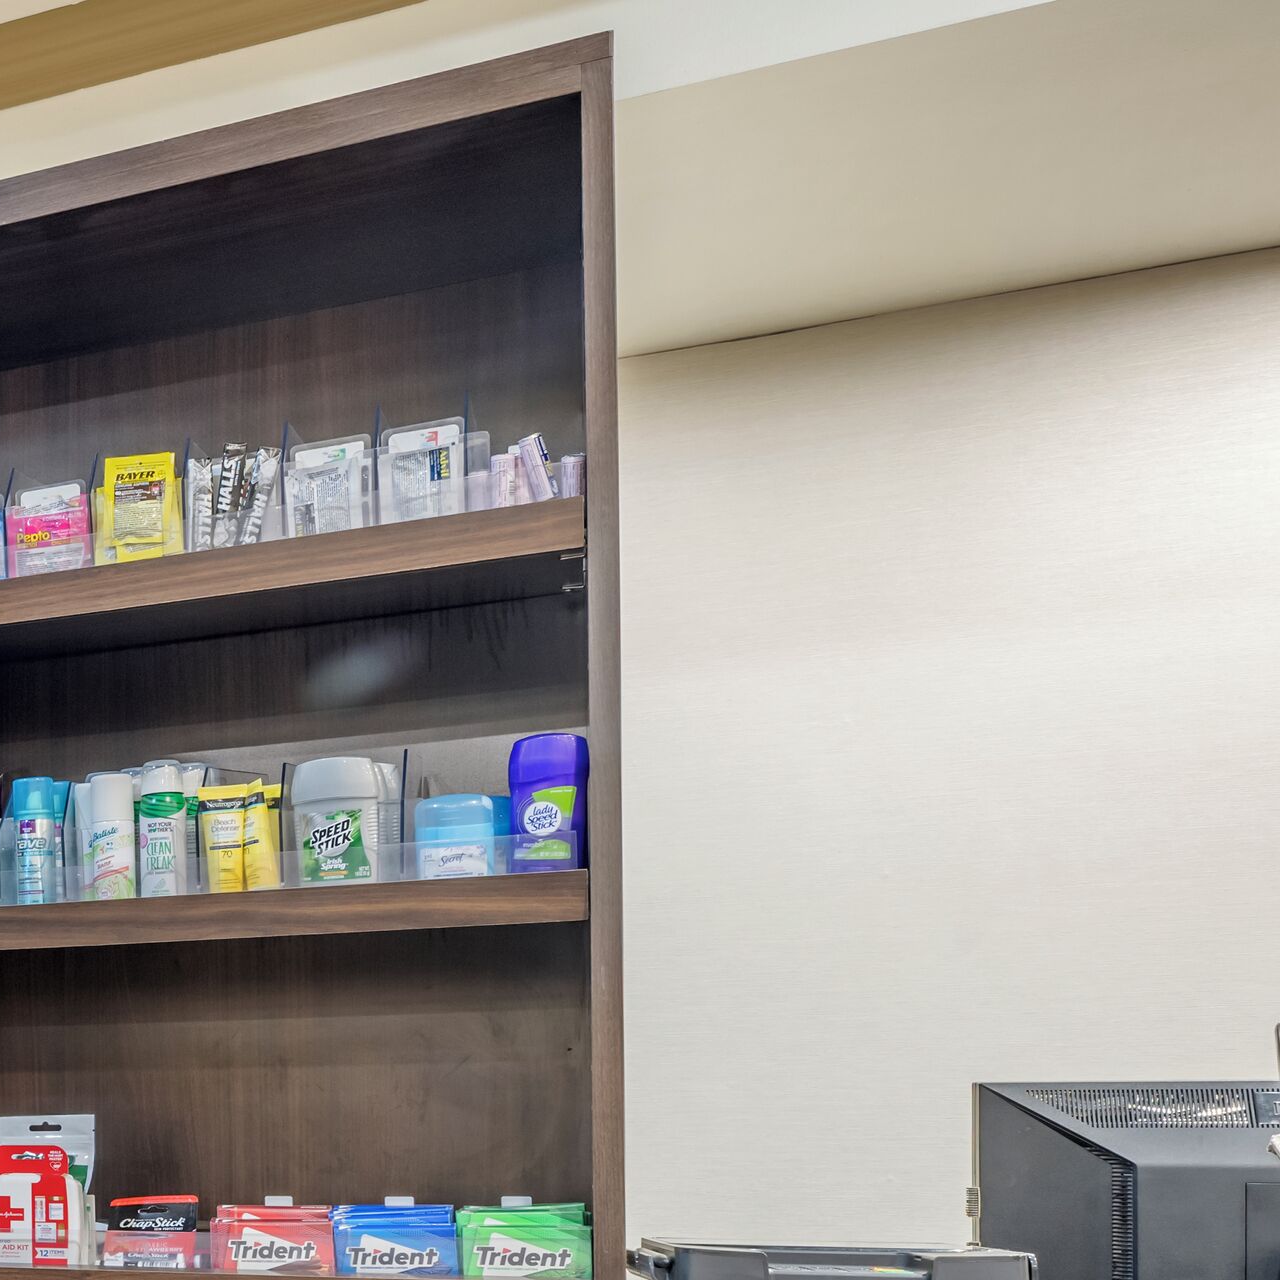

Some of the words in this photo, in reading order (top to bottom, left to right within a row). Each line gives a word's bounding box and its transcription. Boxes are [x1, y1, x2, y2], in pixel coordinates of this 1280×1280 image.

[116, 470, 155, 481] BAYER
[218, 459, 236, 511] HALLS
[17, 531, 50, 544] Pepto
[207, 800, 243, 809] Neutrogena
[533, 805, 553, 816] lady
[526, 812, 557, 825] Speed
[92, 826, 119, 838] Batiste
[312, 819, 350, 844] SPEED
[531, 821, 556, 831] Stick
[147, 842, 171, 855] CLEAN
[317, 831, 351, 855] STICK
[222, 850, 232, 858] 70
[440, 853, 465, 867] Secret
[120, 1217, 185, 1229] ChapStick
[230, 1240, 315, 1259] Trident
[348, 1247, 438, 1266] Trident
[477, 1246, 571, 1267] Trident
